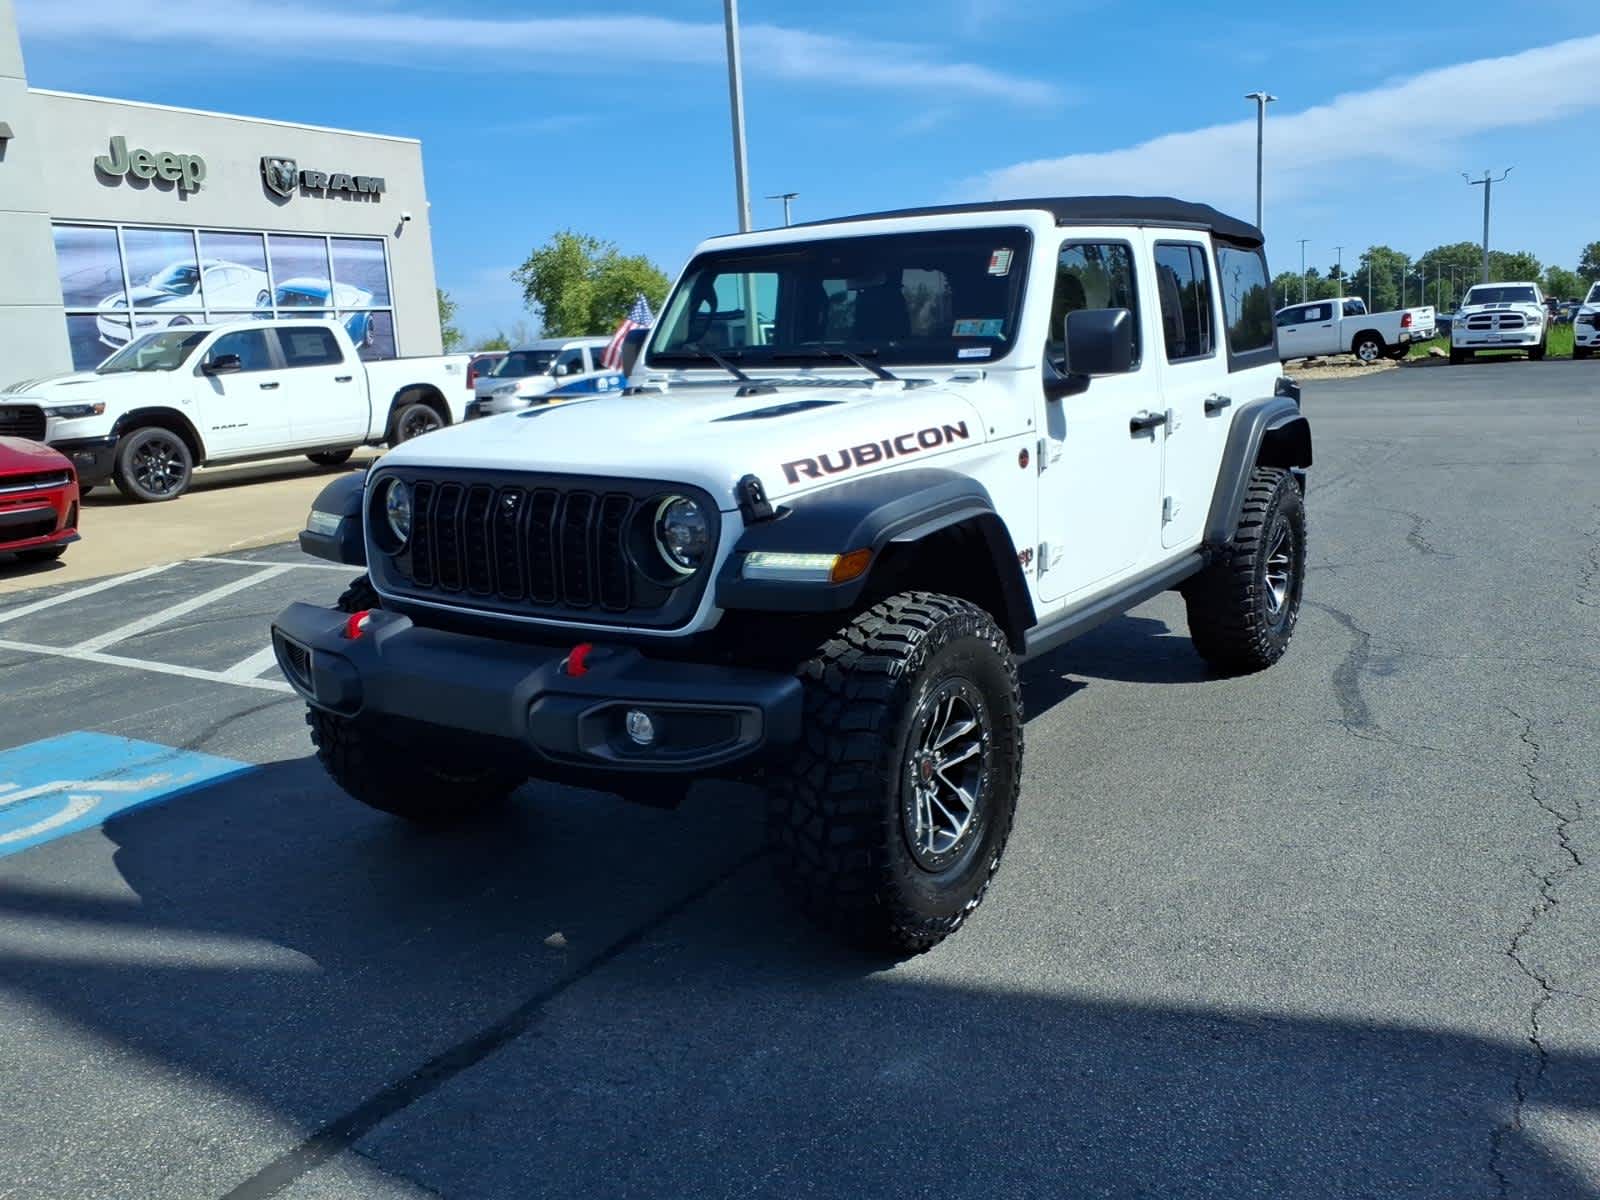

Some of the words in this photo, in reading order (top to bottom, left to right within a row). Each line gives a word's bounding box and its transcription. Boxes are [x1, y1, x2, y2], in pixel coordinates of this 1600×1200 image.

[94, 136, 206, 191] Jeep
[300, 170, 386, 193] RAM
[781, 421, 969, 484] RUBICON
